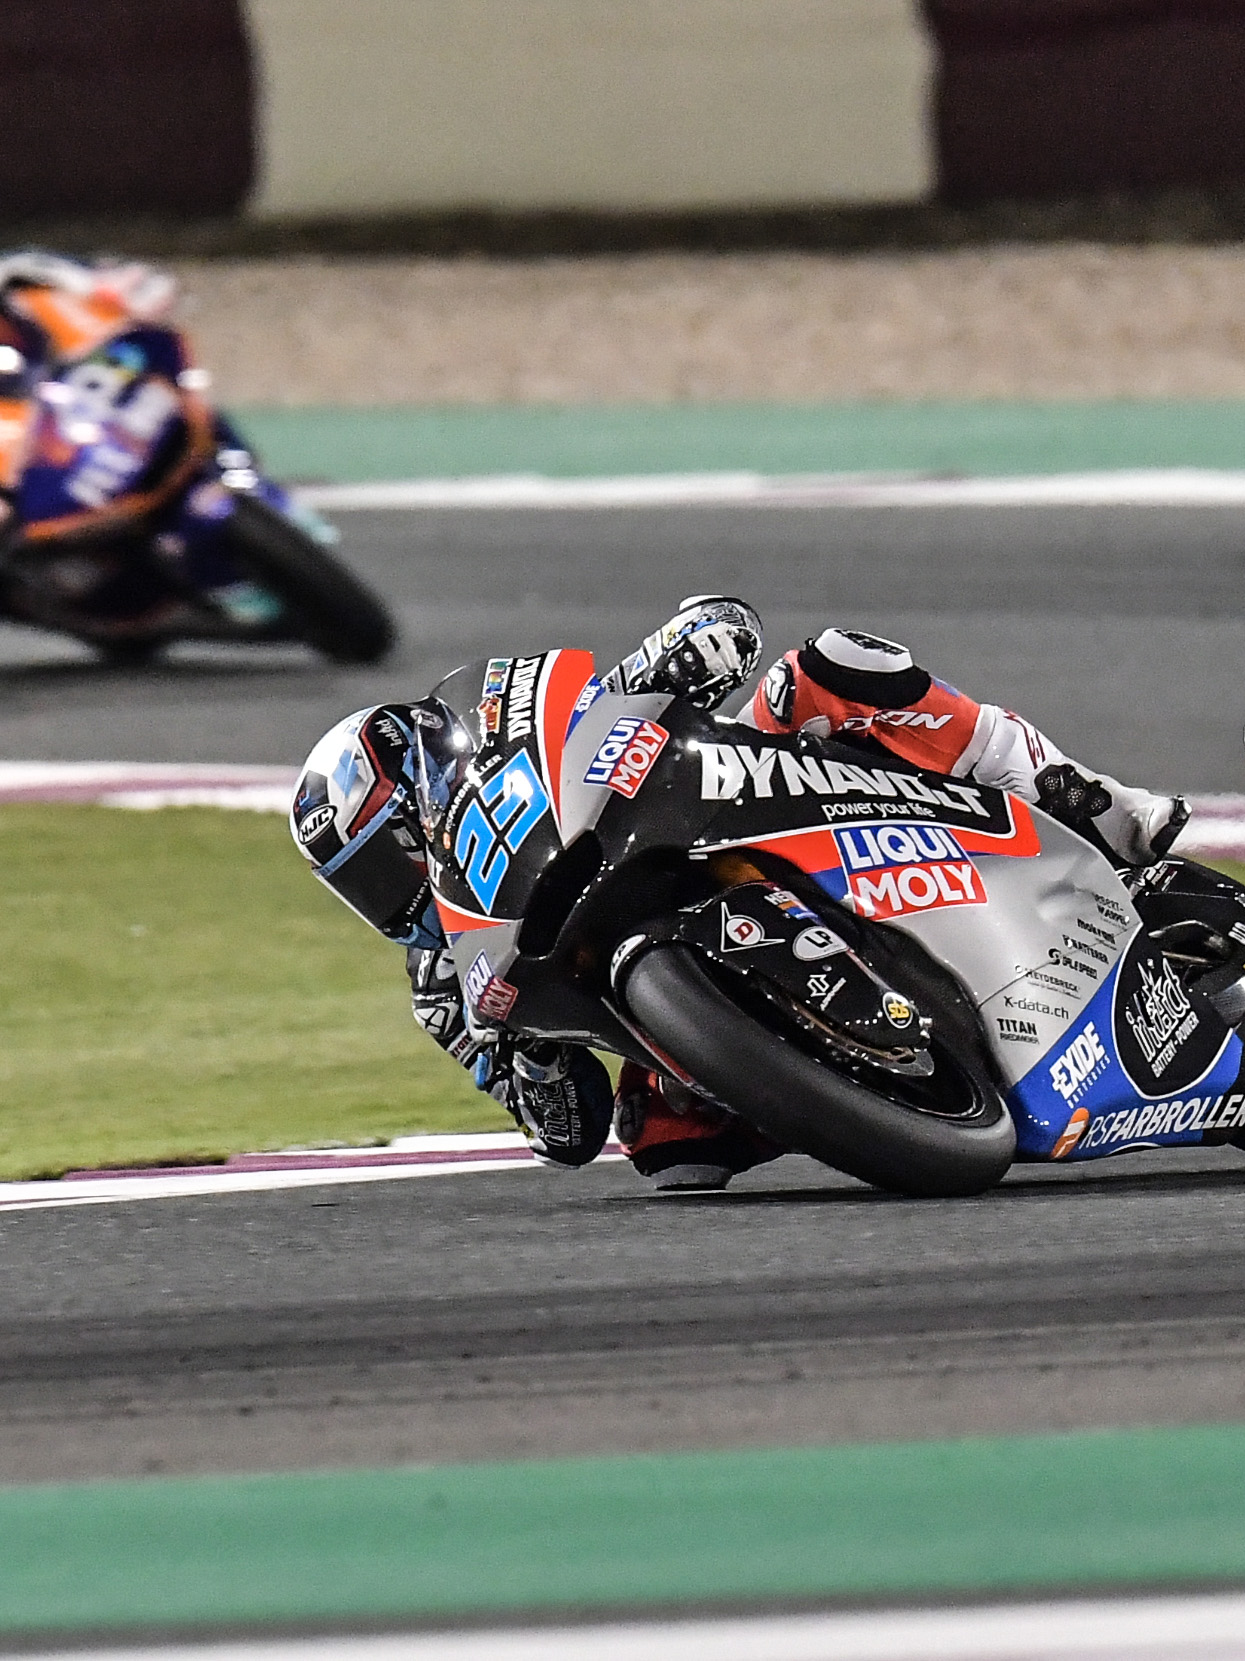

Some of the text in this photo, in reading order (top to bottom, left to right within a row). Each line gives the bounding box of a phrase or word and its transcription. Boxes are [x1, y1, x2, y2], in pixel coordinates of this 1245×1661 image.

[507, 657, 541, 742] DYNAVOLT
[588, 717, 643, 785] LIQUI
[613, 721, 665, 797] MOLY
[700, 742, 991, 819] DYNAVOLT
[300, 807, 331, 842] HJC
[454, 747, 549, 915] 23
[820, 800, 937, 821] power your life
[844, 826, 961, 869] LIQUI
[855, 863, 976, 917] MOLY
[804, 929, 834, 949] LP
[997, 1017, 1038, 1037] TITAN
[1049, 1020, 1106, 1100] EXIDE
